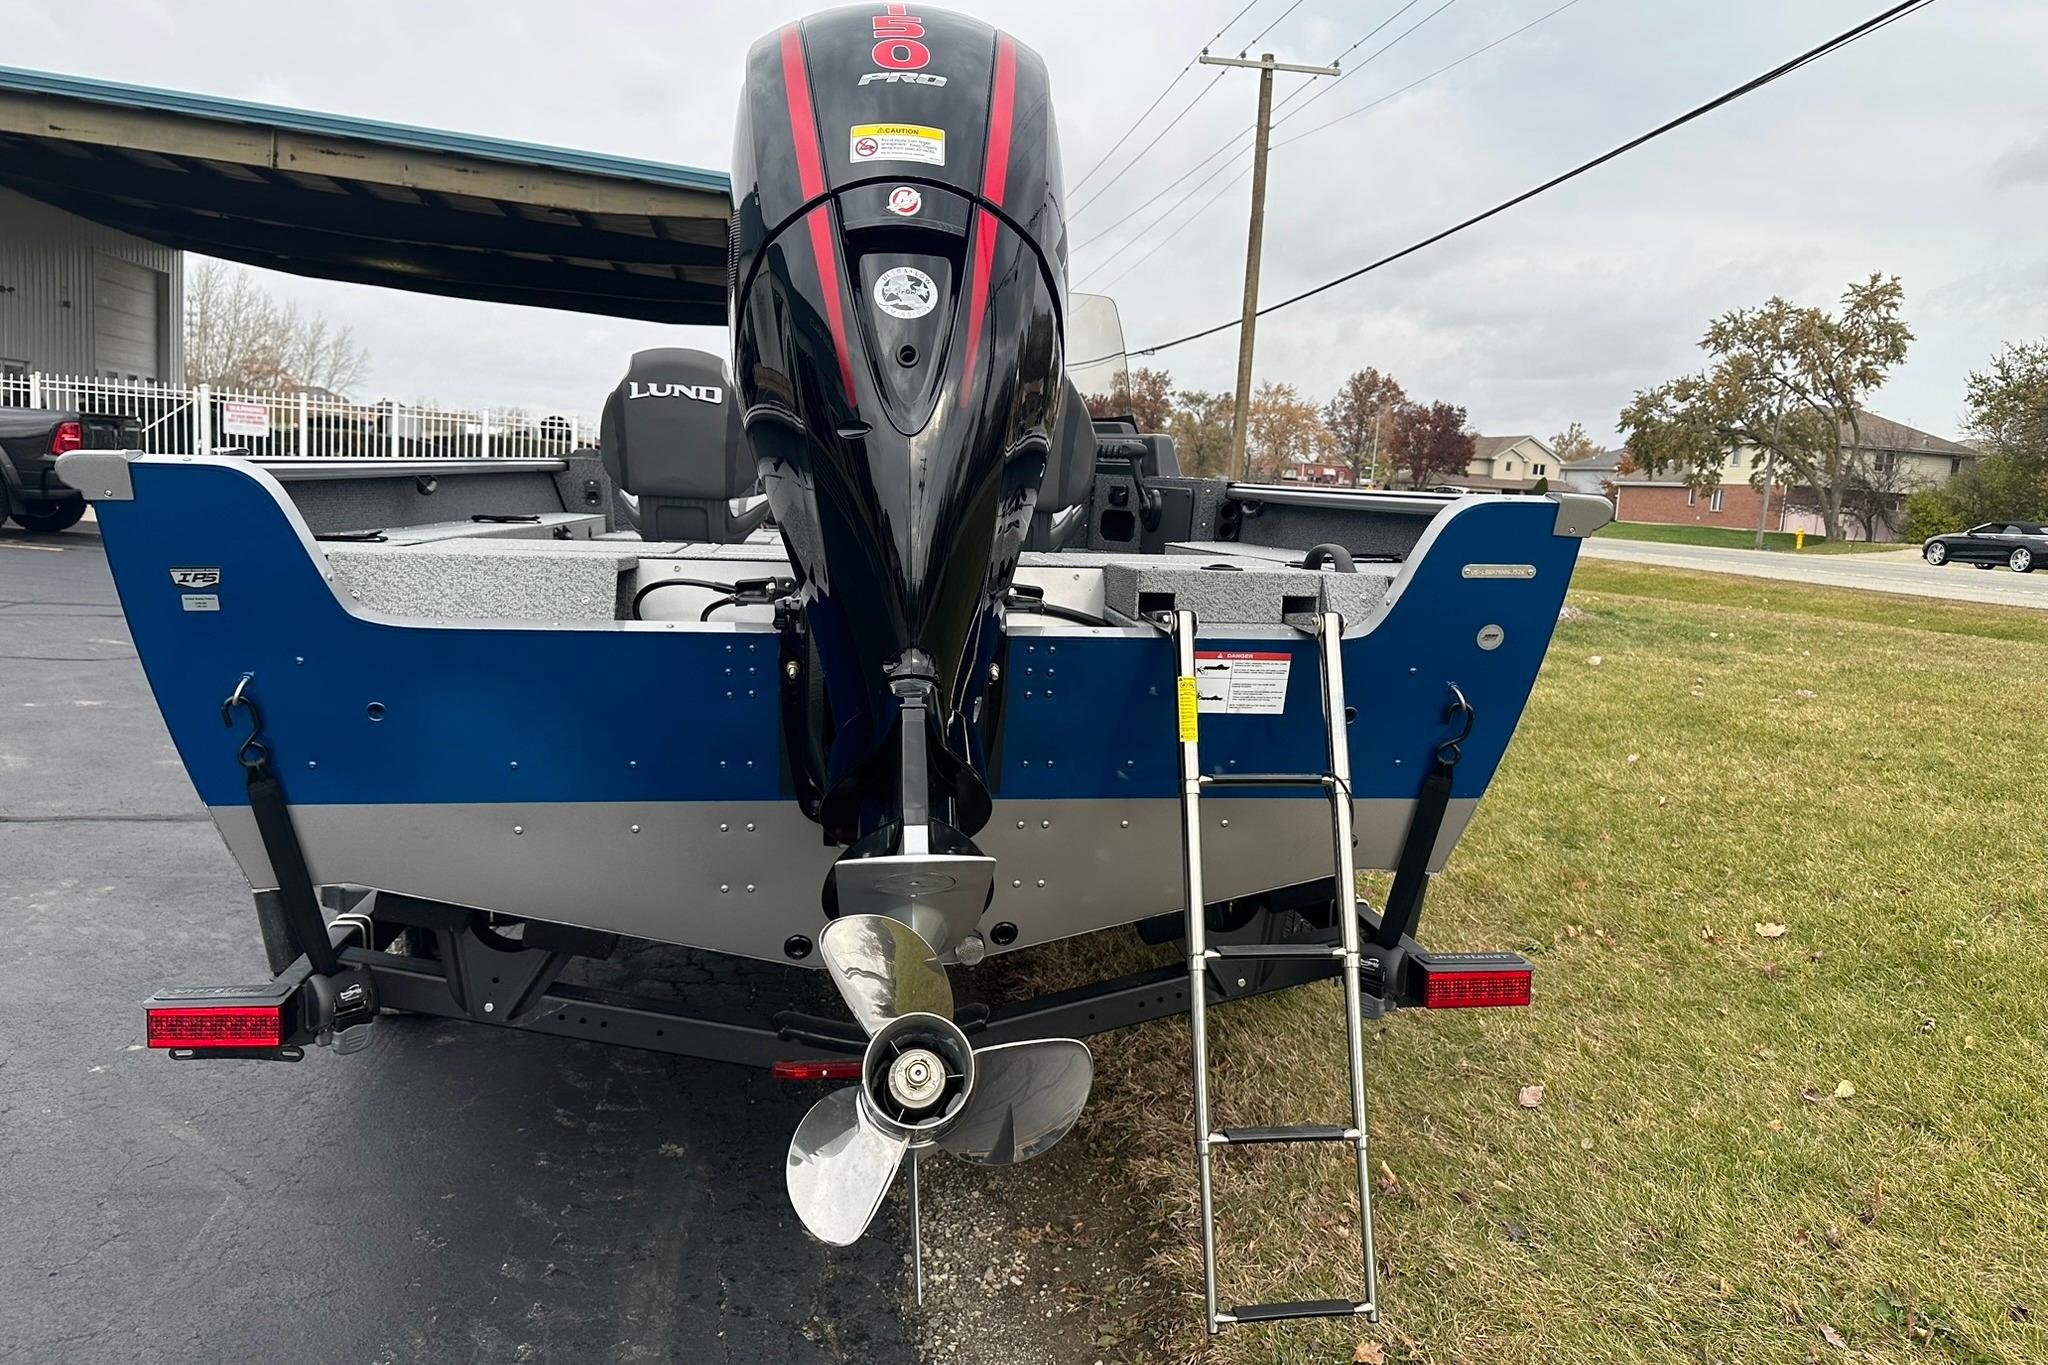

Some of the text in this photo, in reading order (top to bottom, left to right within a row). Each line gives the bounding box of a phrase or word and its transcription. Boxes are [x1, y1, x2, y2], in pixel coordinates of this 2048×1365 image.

[858, 72, 947, 87] PRO
[629, 382, 722, 404] LUND
[178, 573, 218, 583] IPS
